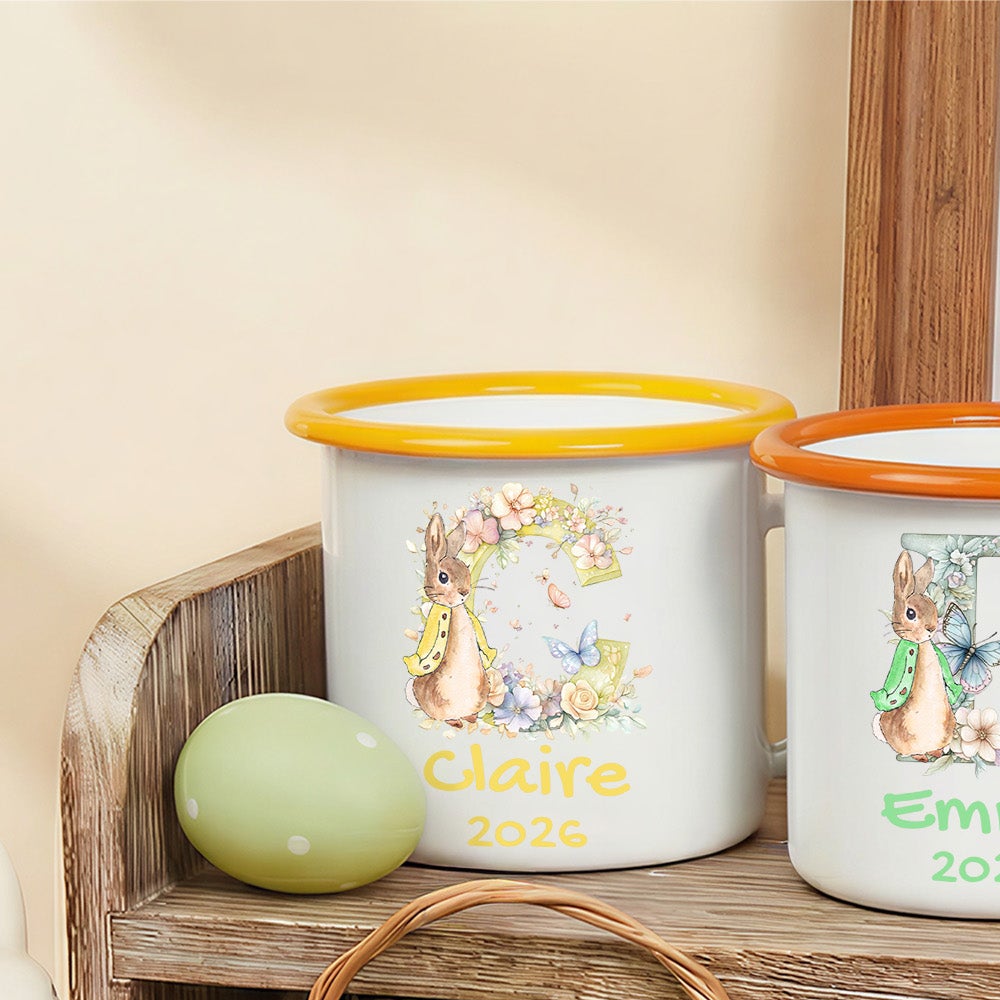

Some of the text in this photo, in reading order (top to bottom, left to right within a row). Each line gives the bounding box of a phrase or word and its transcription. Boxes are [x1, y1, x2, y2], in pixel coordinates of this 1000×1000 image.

[422, 486, 632, 733] C
[422, 742, 632, 799] Claire
[466, 815, 589, 849] 2026
